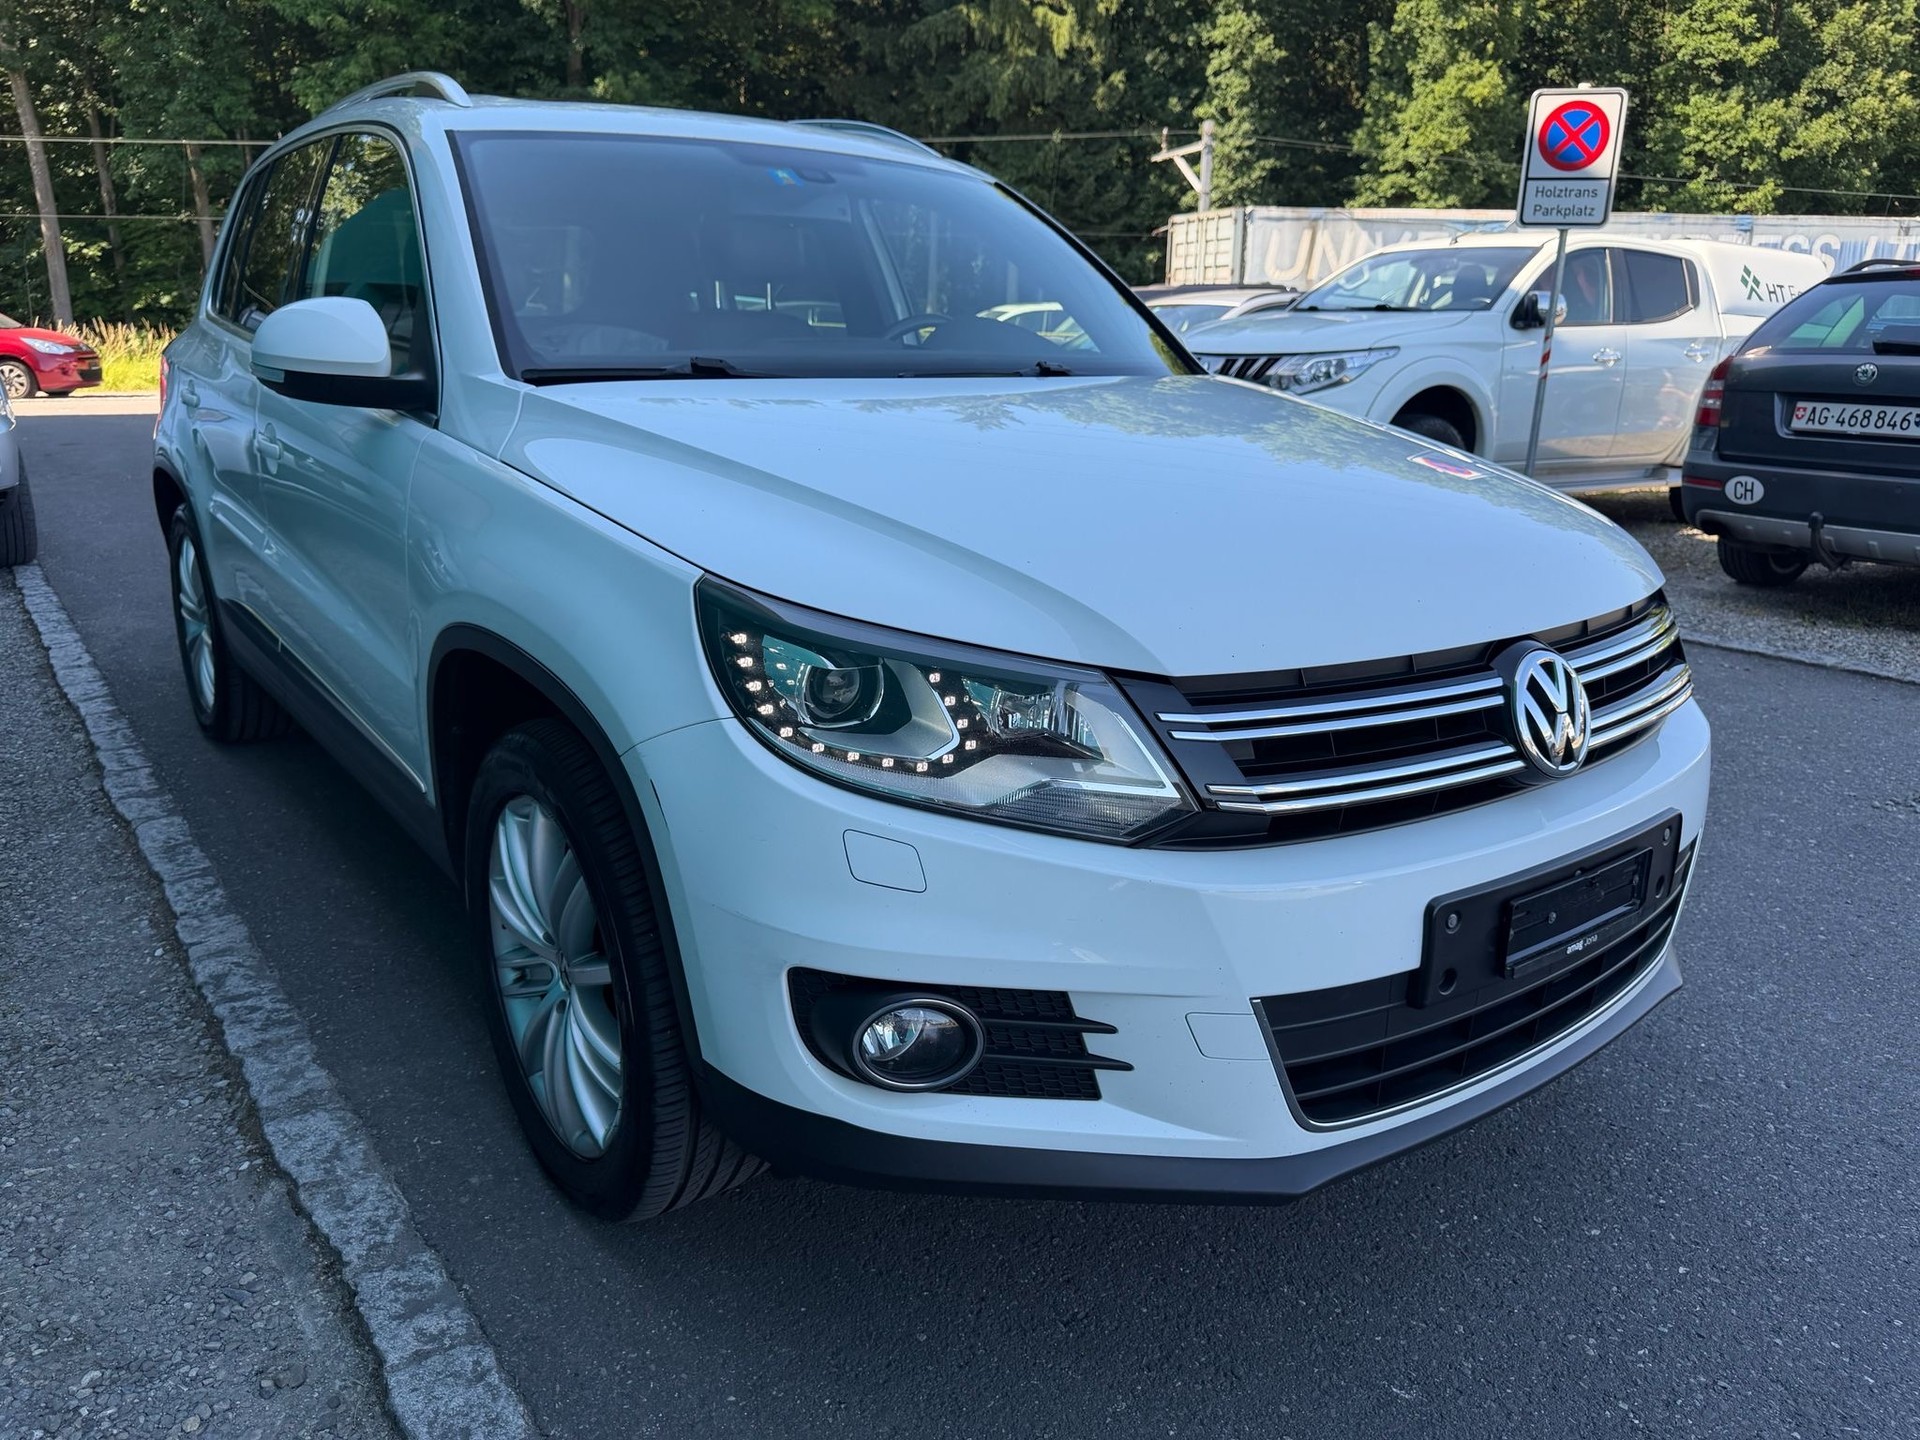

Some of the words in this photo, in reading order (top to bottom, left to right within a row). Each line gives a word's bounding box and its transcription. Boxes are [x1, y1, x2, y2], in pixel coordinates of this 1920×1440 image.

[1535, 185, 1598, 198] Holztrans
[1533, 204, 1595, 219] Parkplatz
[1766, 283, 1785, 303] HT
[1734, 481, 1755, 501] CH
